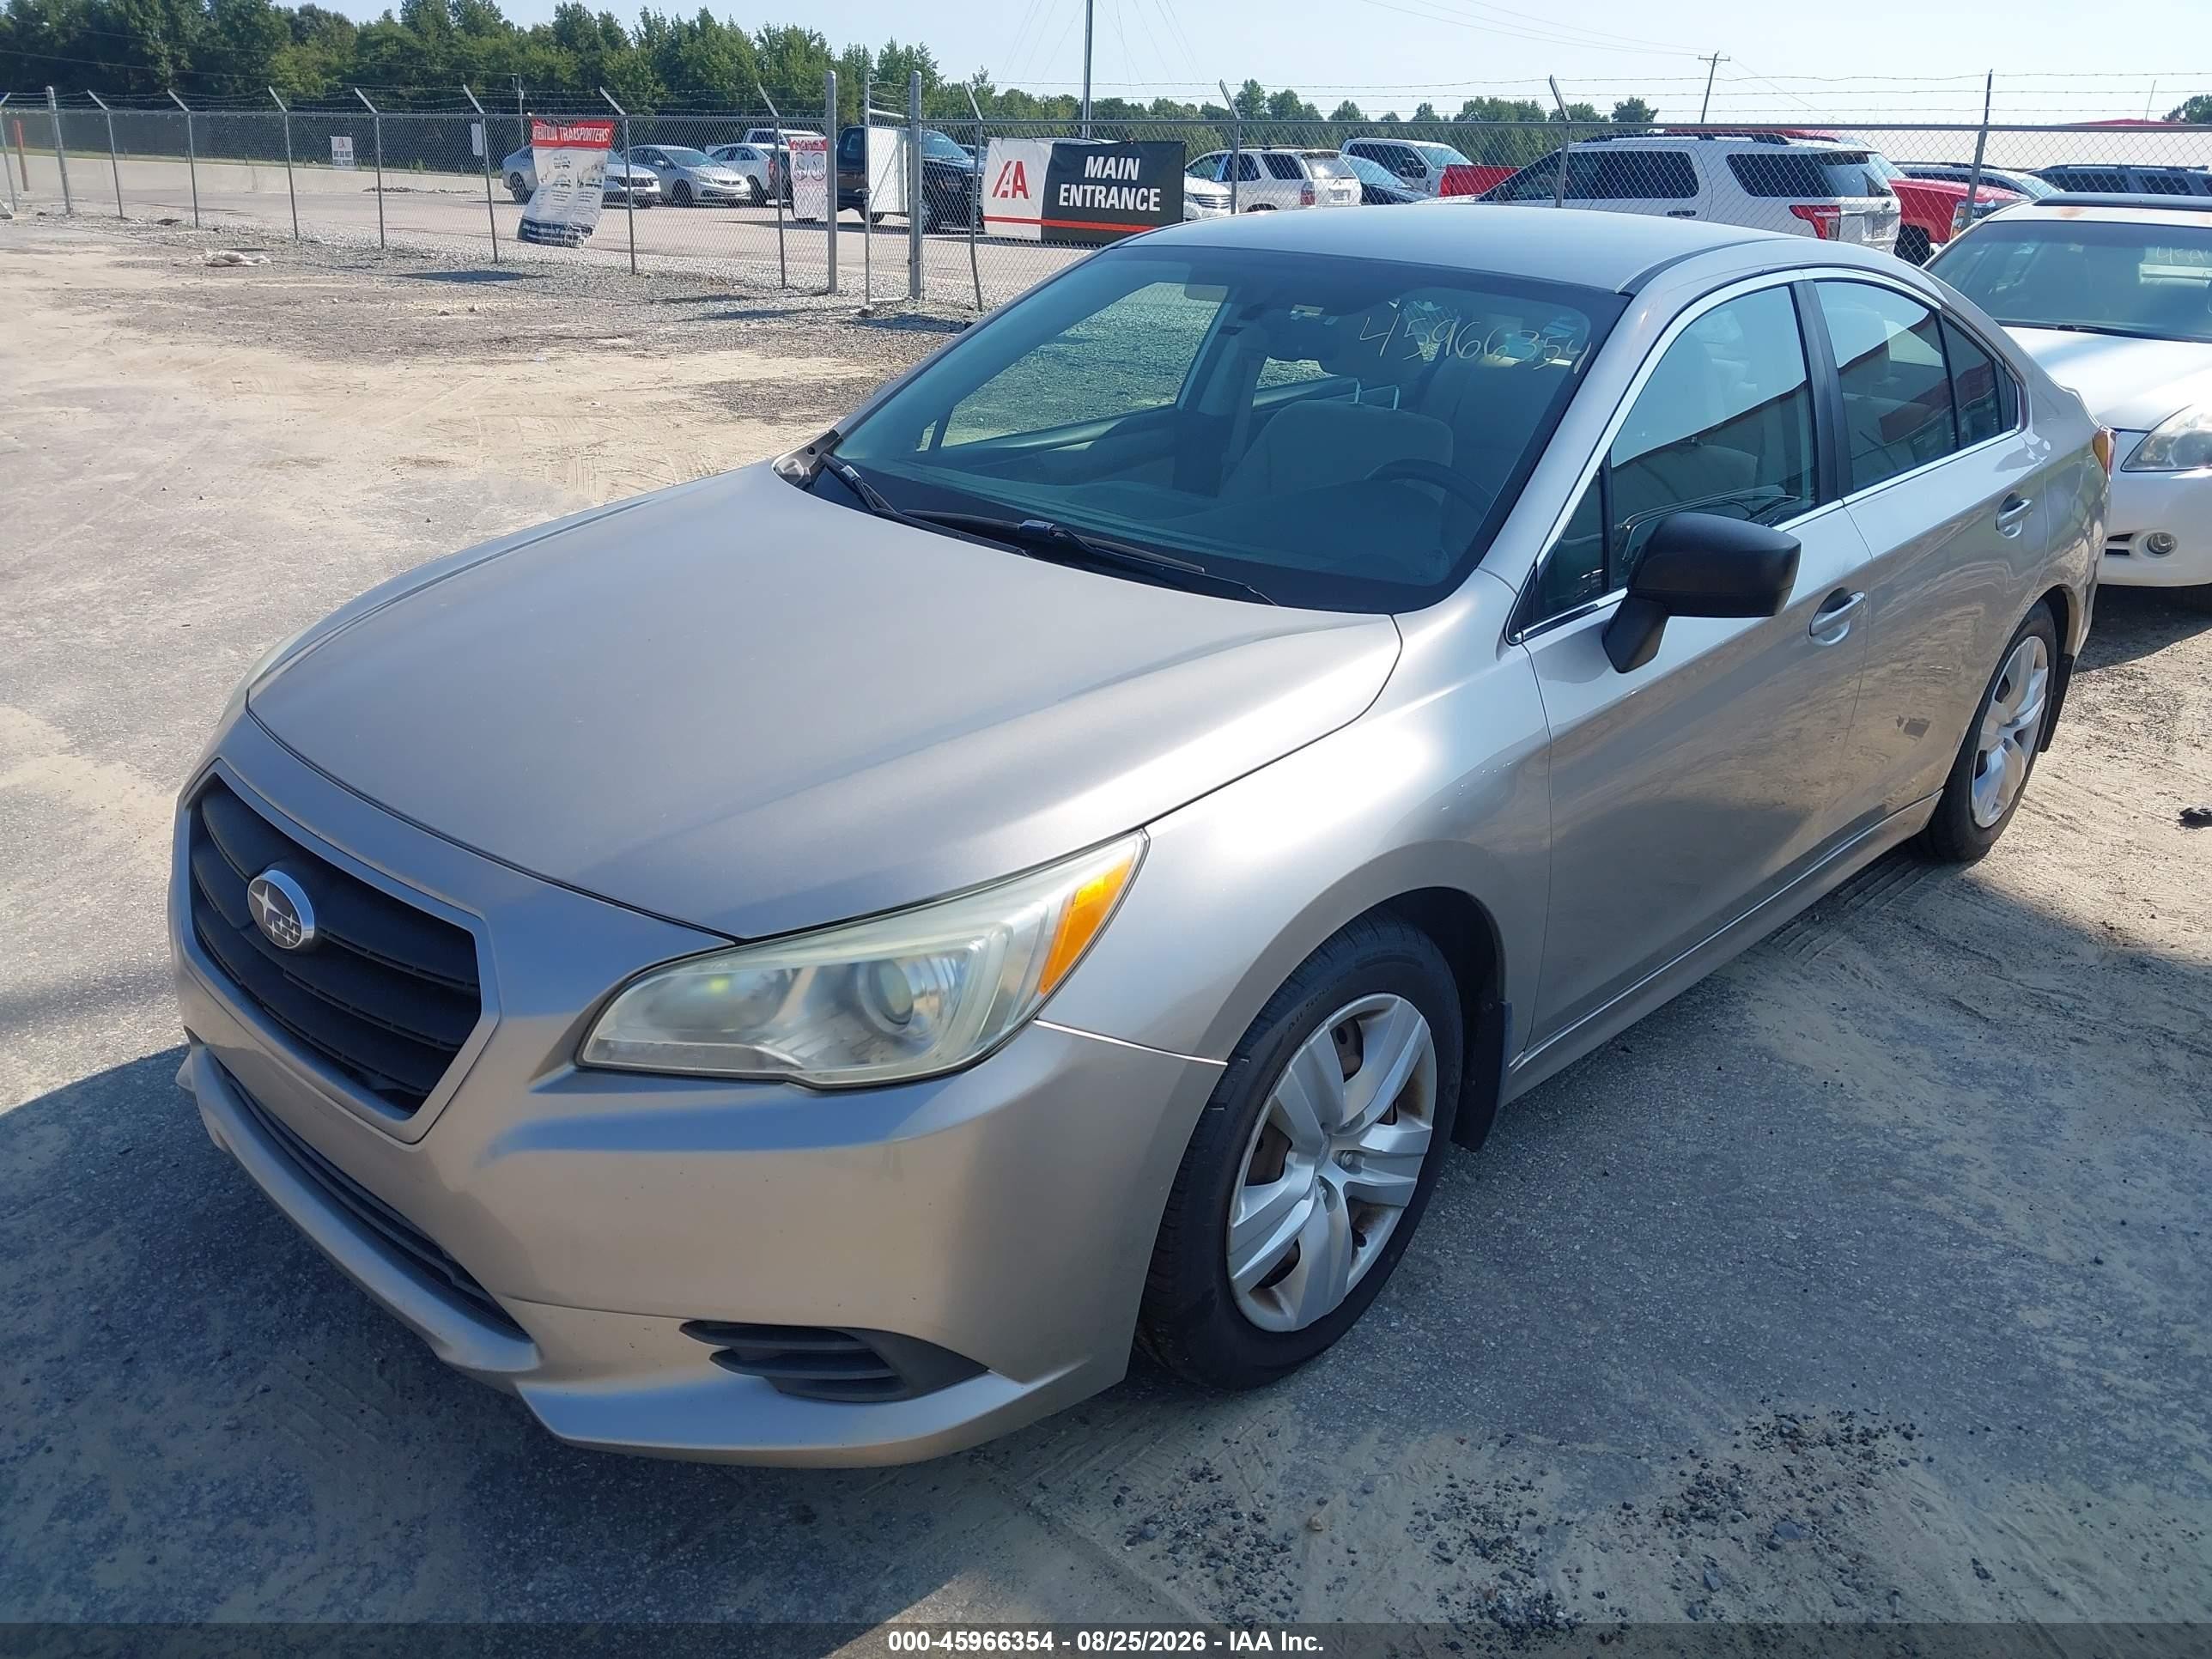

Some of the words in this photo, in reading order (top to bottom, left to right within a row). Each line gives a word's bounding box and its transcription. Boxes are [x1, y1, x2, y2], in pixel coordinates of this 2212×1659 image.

[559, 127, 611, 143] TRANSPORTERS
[1084, 155, 1140, 181] MAIN
[1058, 183, 1162, 212] ENTRANCE
[1359, 313, 1592, 374] 45966354
